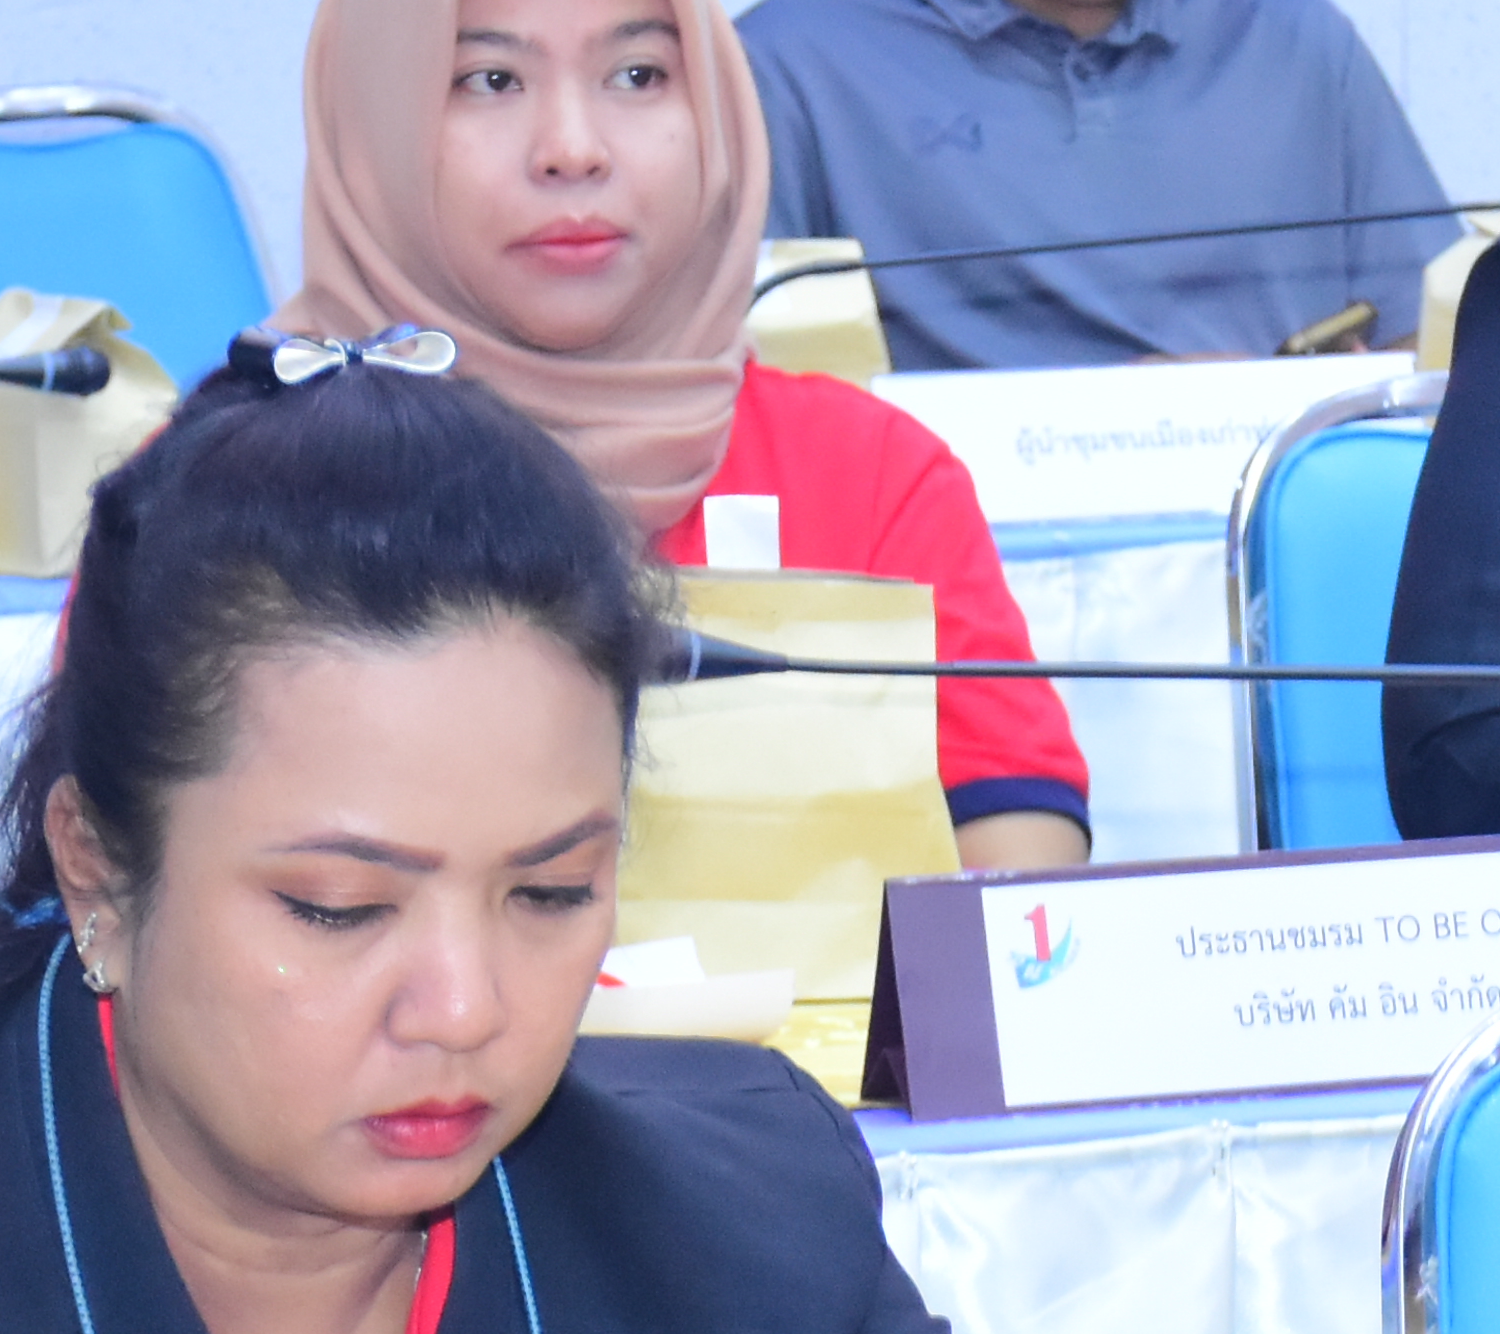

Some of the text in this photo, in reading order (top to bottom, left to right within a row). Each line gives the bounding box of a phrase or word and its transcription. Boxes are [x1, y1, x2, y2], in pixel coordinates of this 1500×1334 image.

[1175, 921, 1365, 959] ประธานชมรม
[1375, 915, 1421, 945] TO
[1432, 911, 1469, 940] BE
[1234, 987, 1316, 1028] บริษัท
